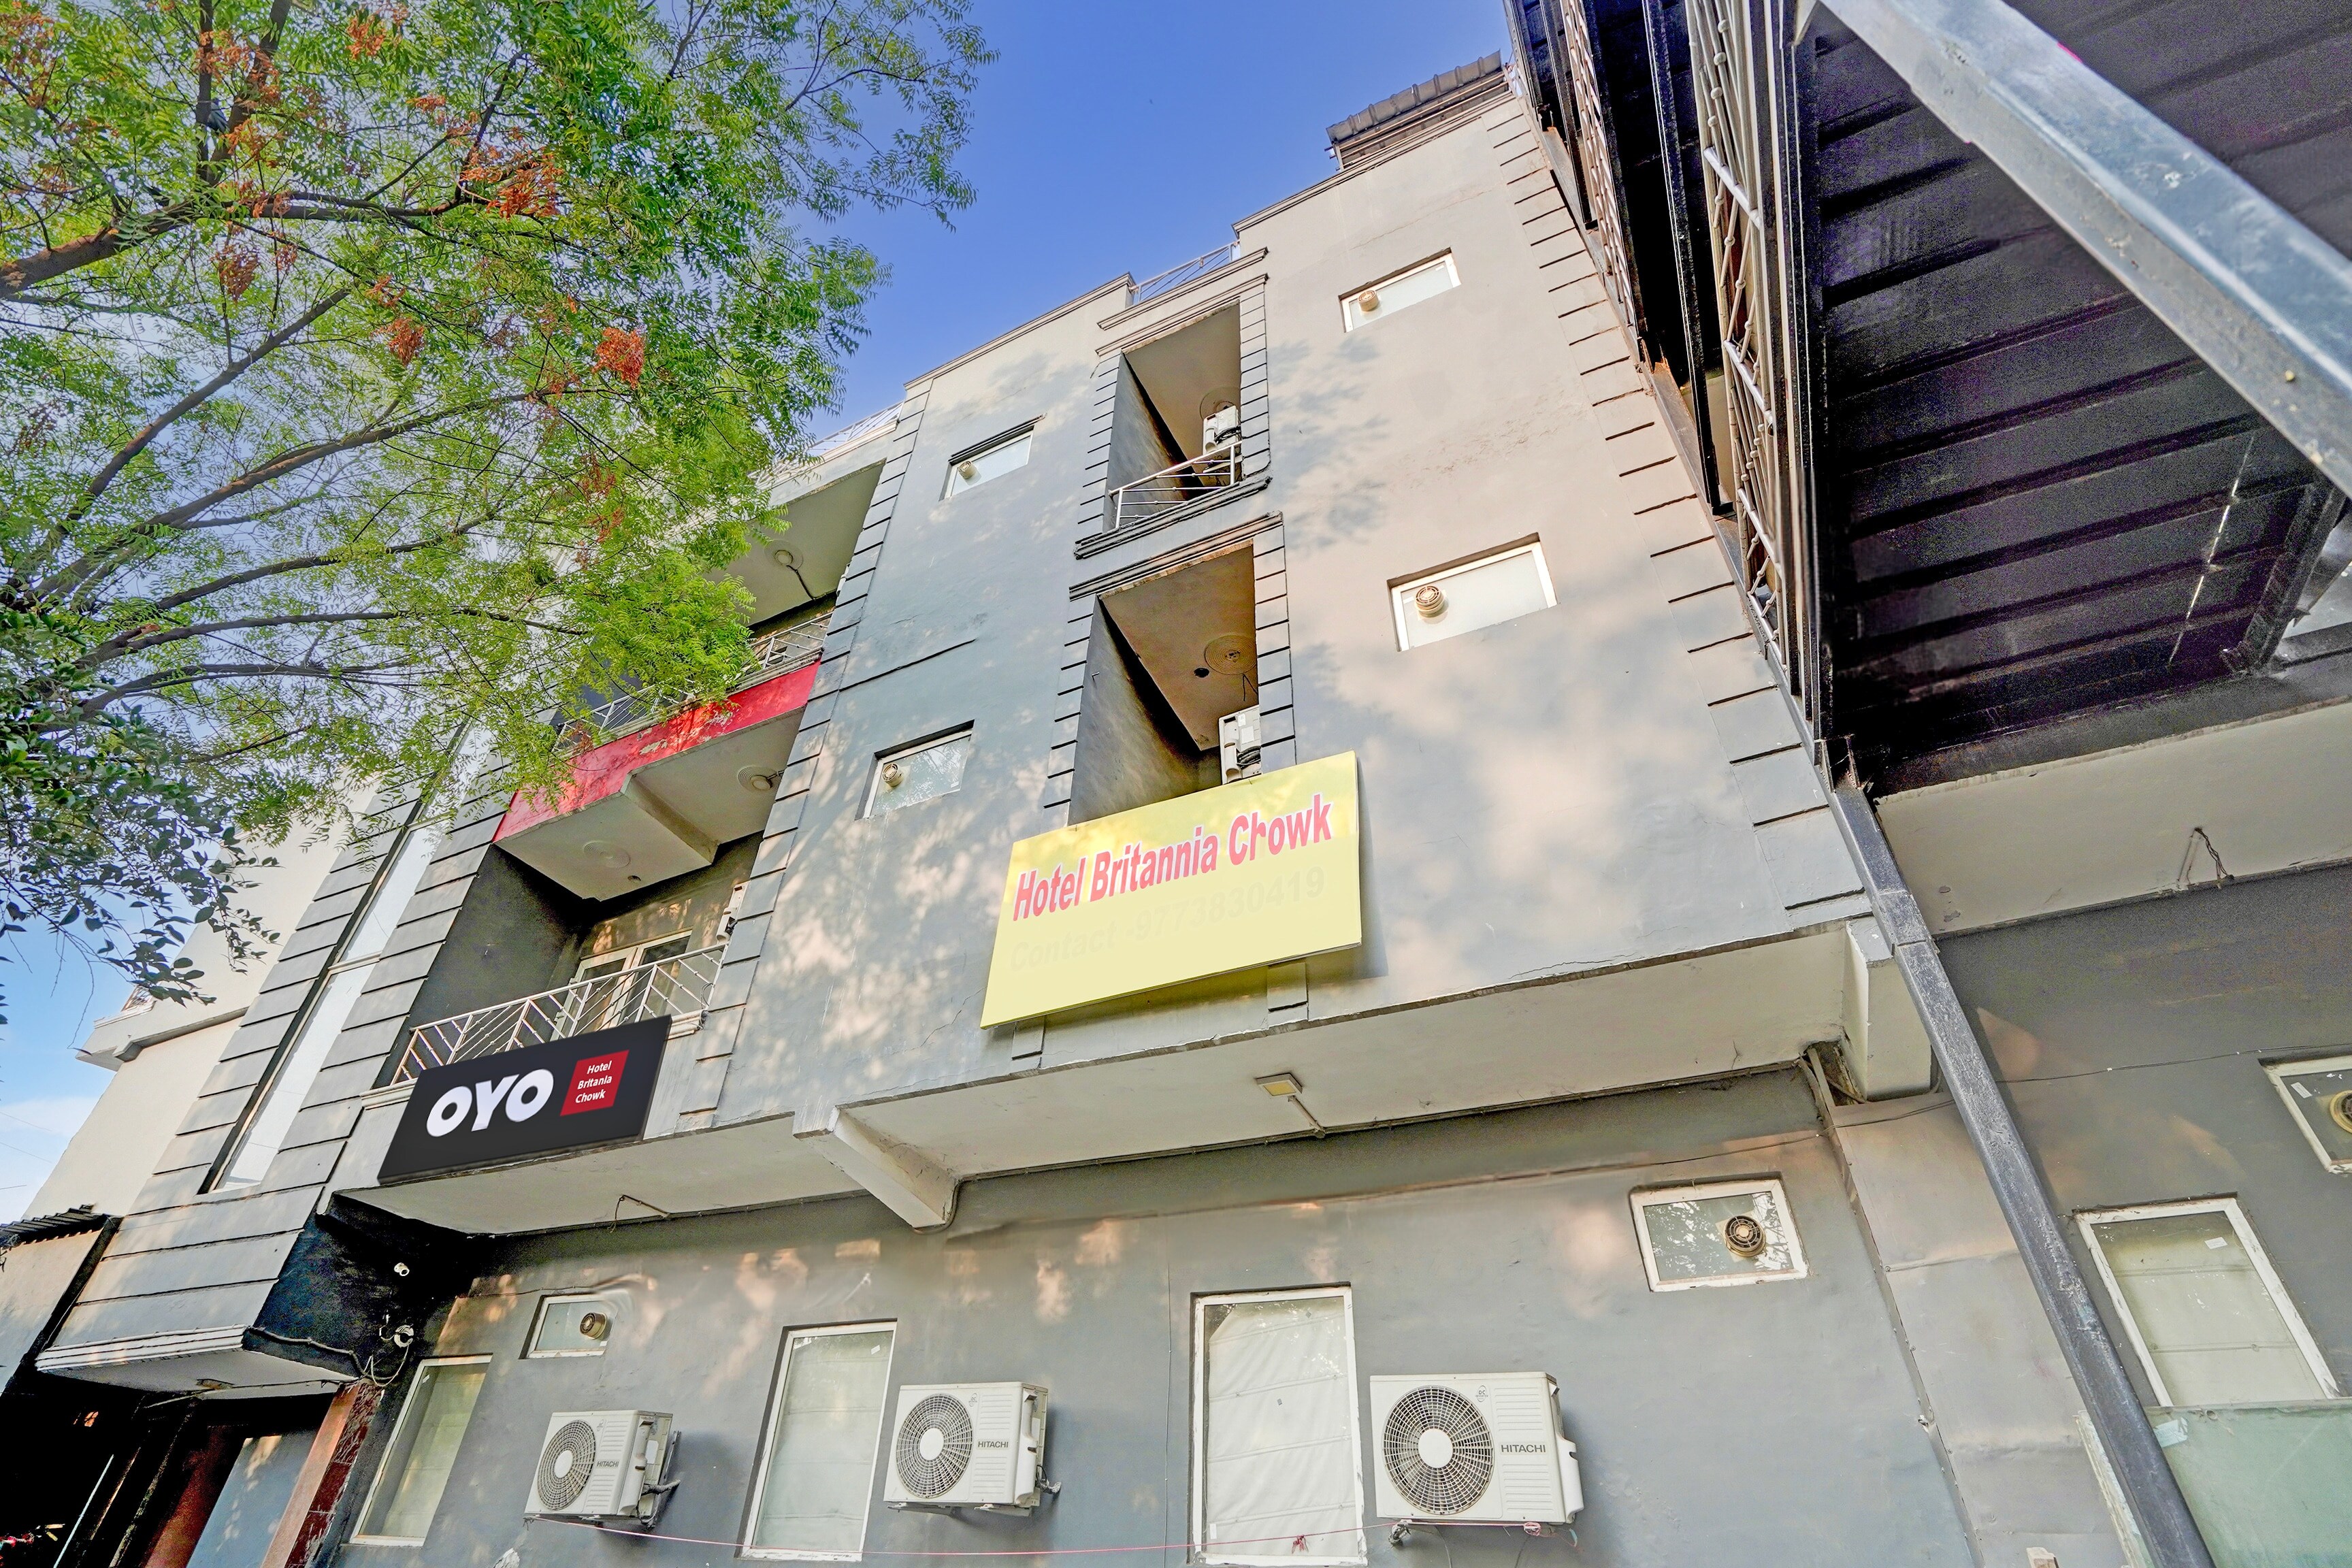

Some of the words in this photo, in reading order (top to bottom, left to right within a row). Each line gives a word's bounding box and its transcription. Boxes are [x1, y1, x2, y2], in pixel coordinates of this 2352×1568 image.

[1013, 858, 1086, 921] Hotel
[1090, 827, 1217, 902] Britannia
[587, 1060, 612, 1075] Hotel
[427, 1069, 554, 1137] OYO
[575, 1089, 606, 1103] Chowk
[1501, 1444, 1546, 1453] HITACHI
